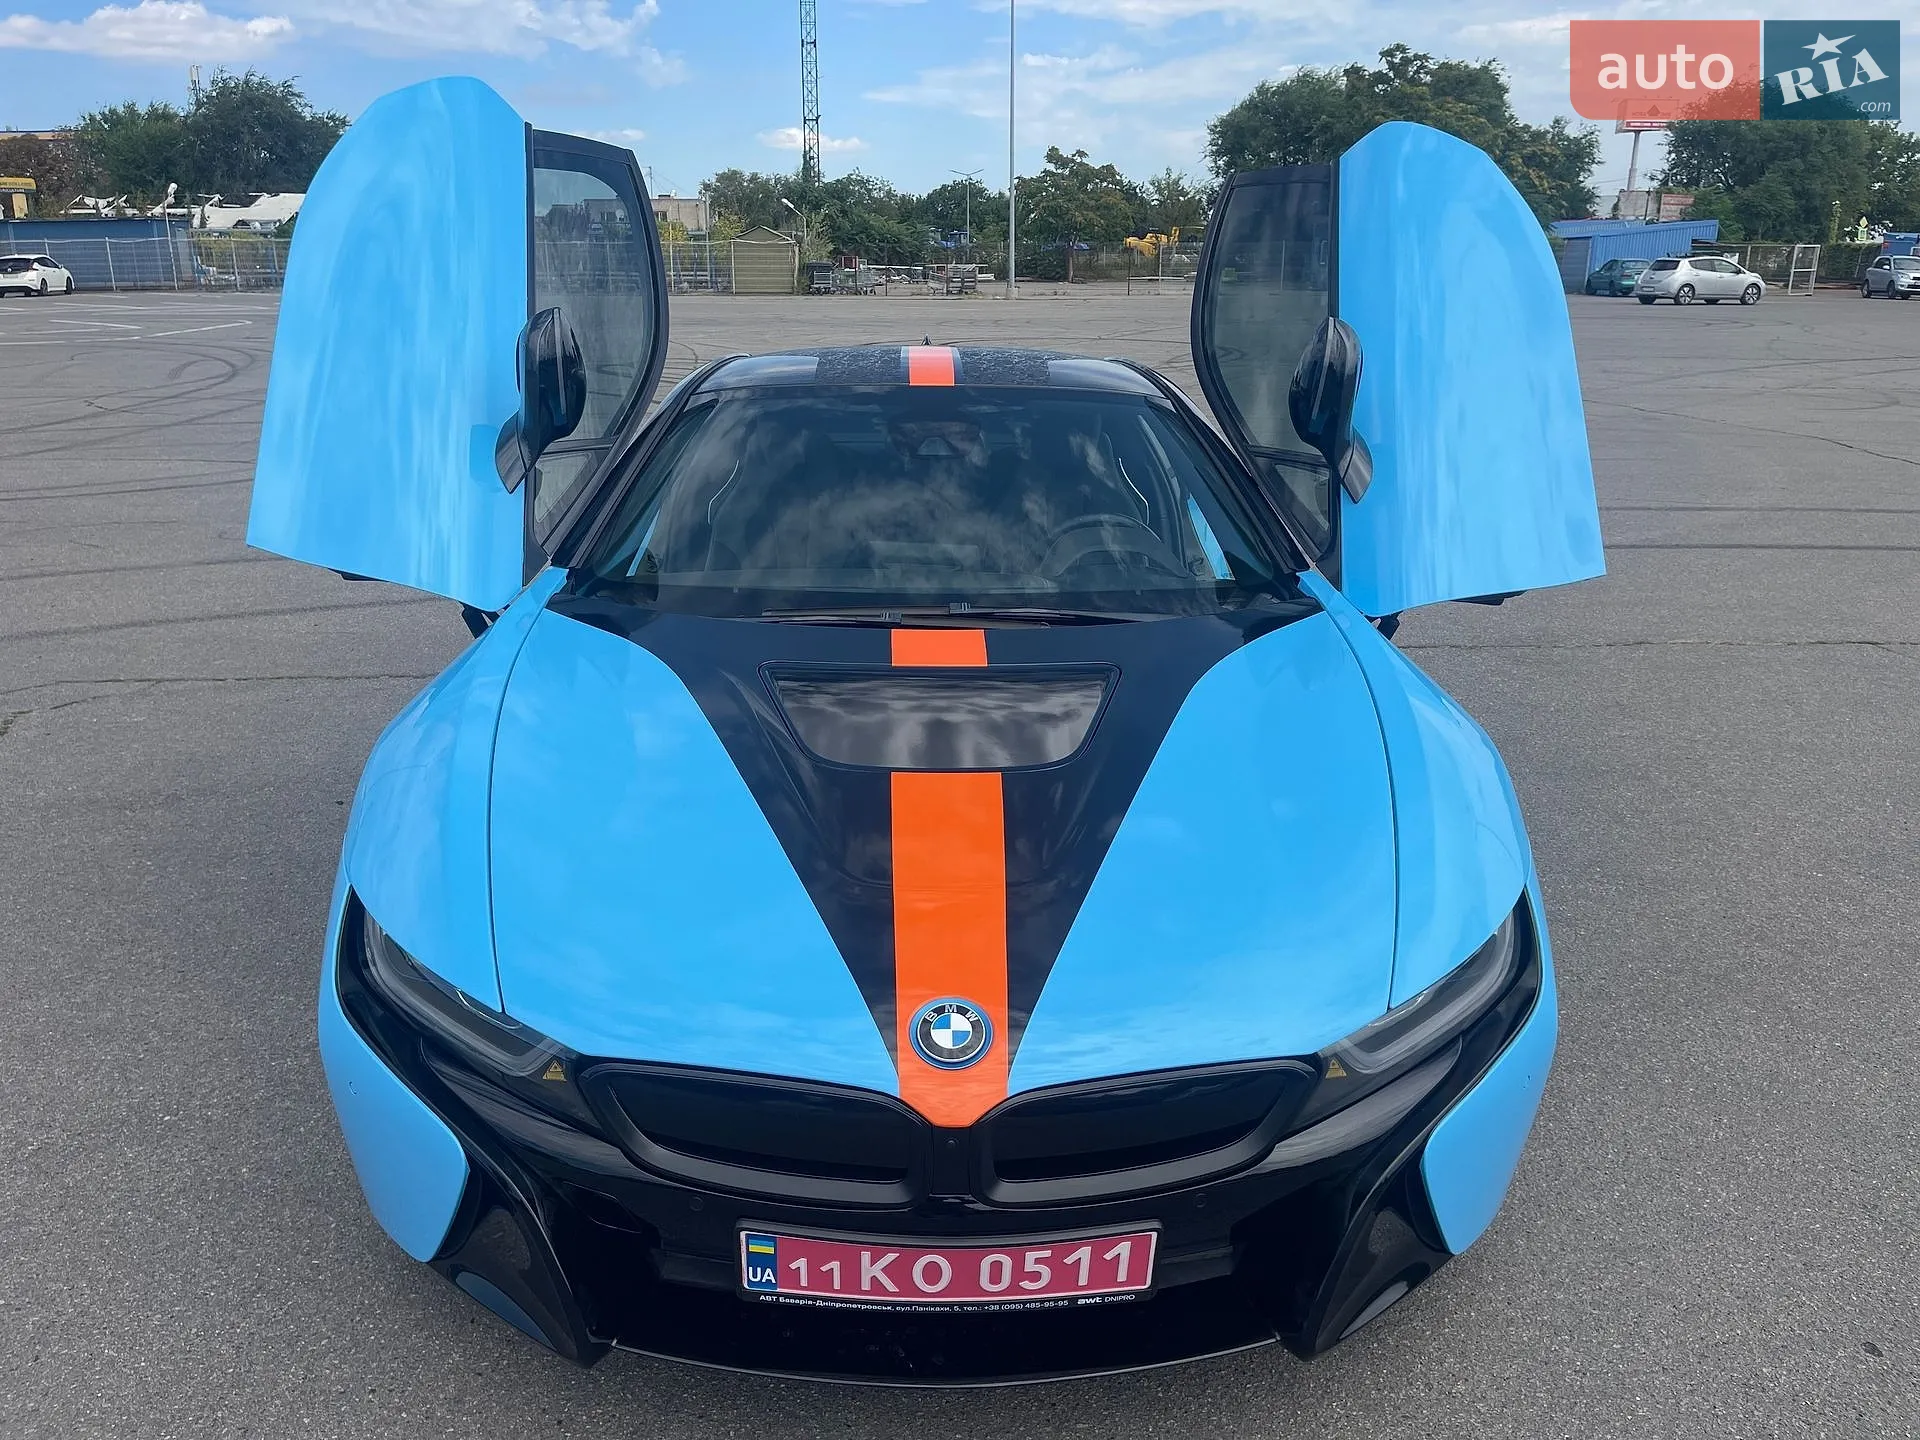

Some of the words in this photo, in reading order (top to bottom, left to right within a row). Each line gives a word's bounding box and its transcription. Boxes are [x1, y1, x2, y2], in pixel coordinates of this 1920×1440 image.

[924, 1004, 978, 1022] BMW
[748, 1266, 776, 1283] UA
[979, 1241, 1132, 1291] 0511
[1001, 1303, 1024, 1311] (095)
[1024, 1300, 1069, 1310] 485-95-95
[1104, 1293, 1136, 1303] DNIPRO
